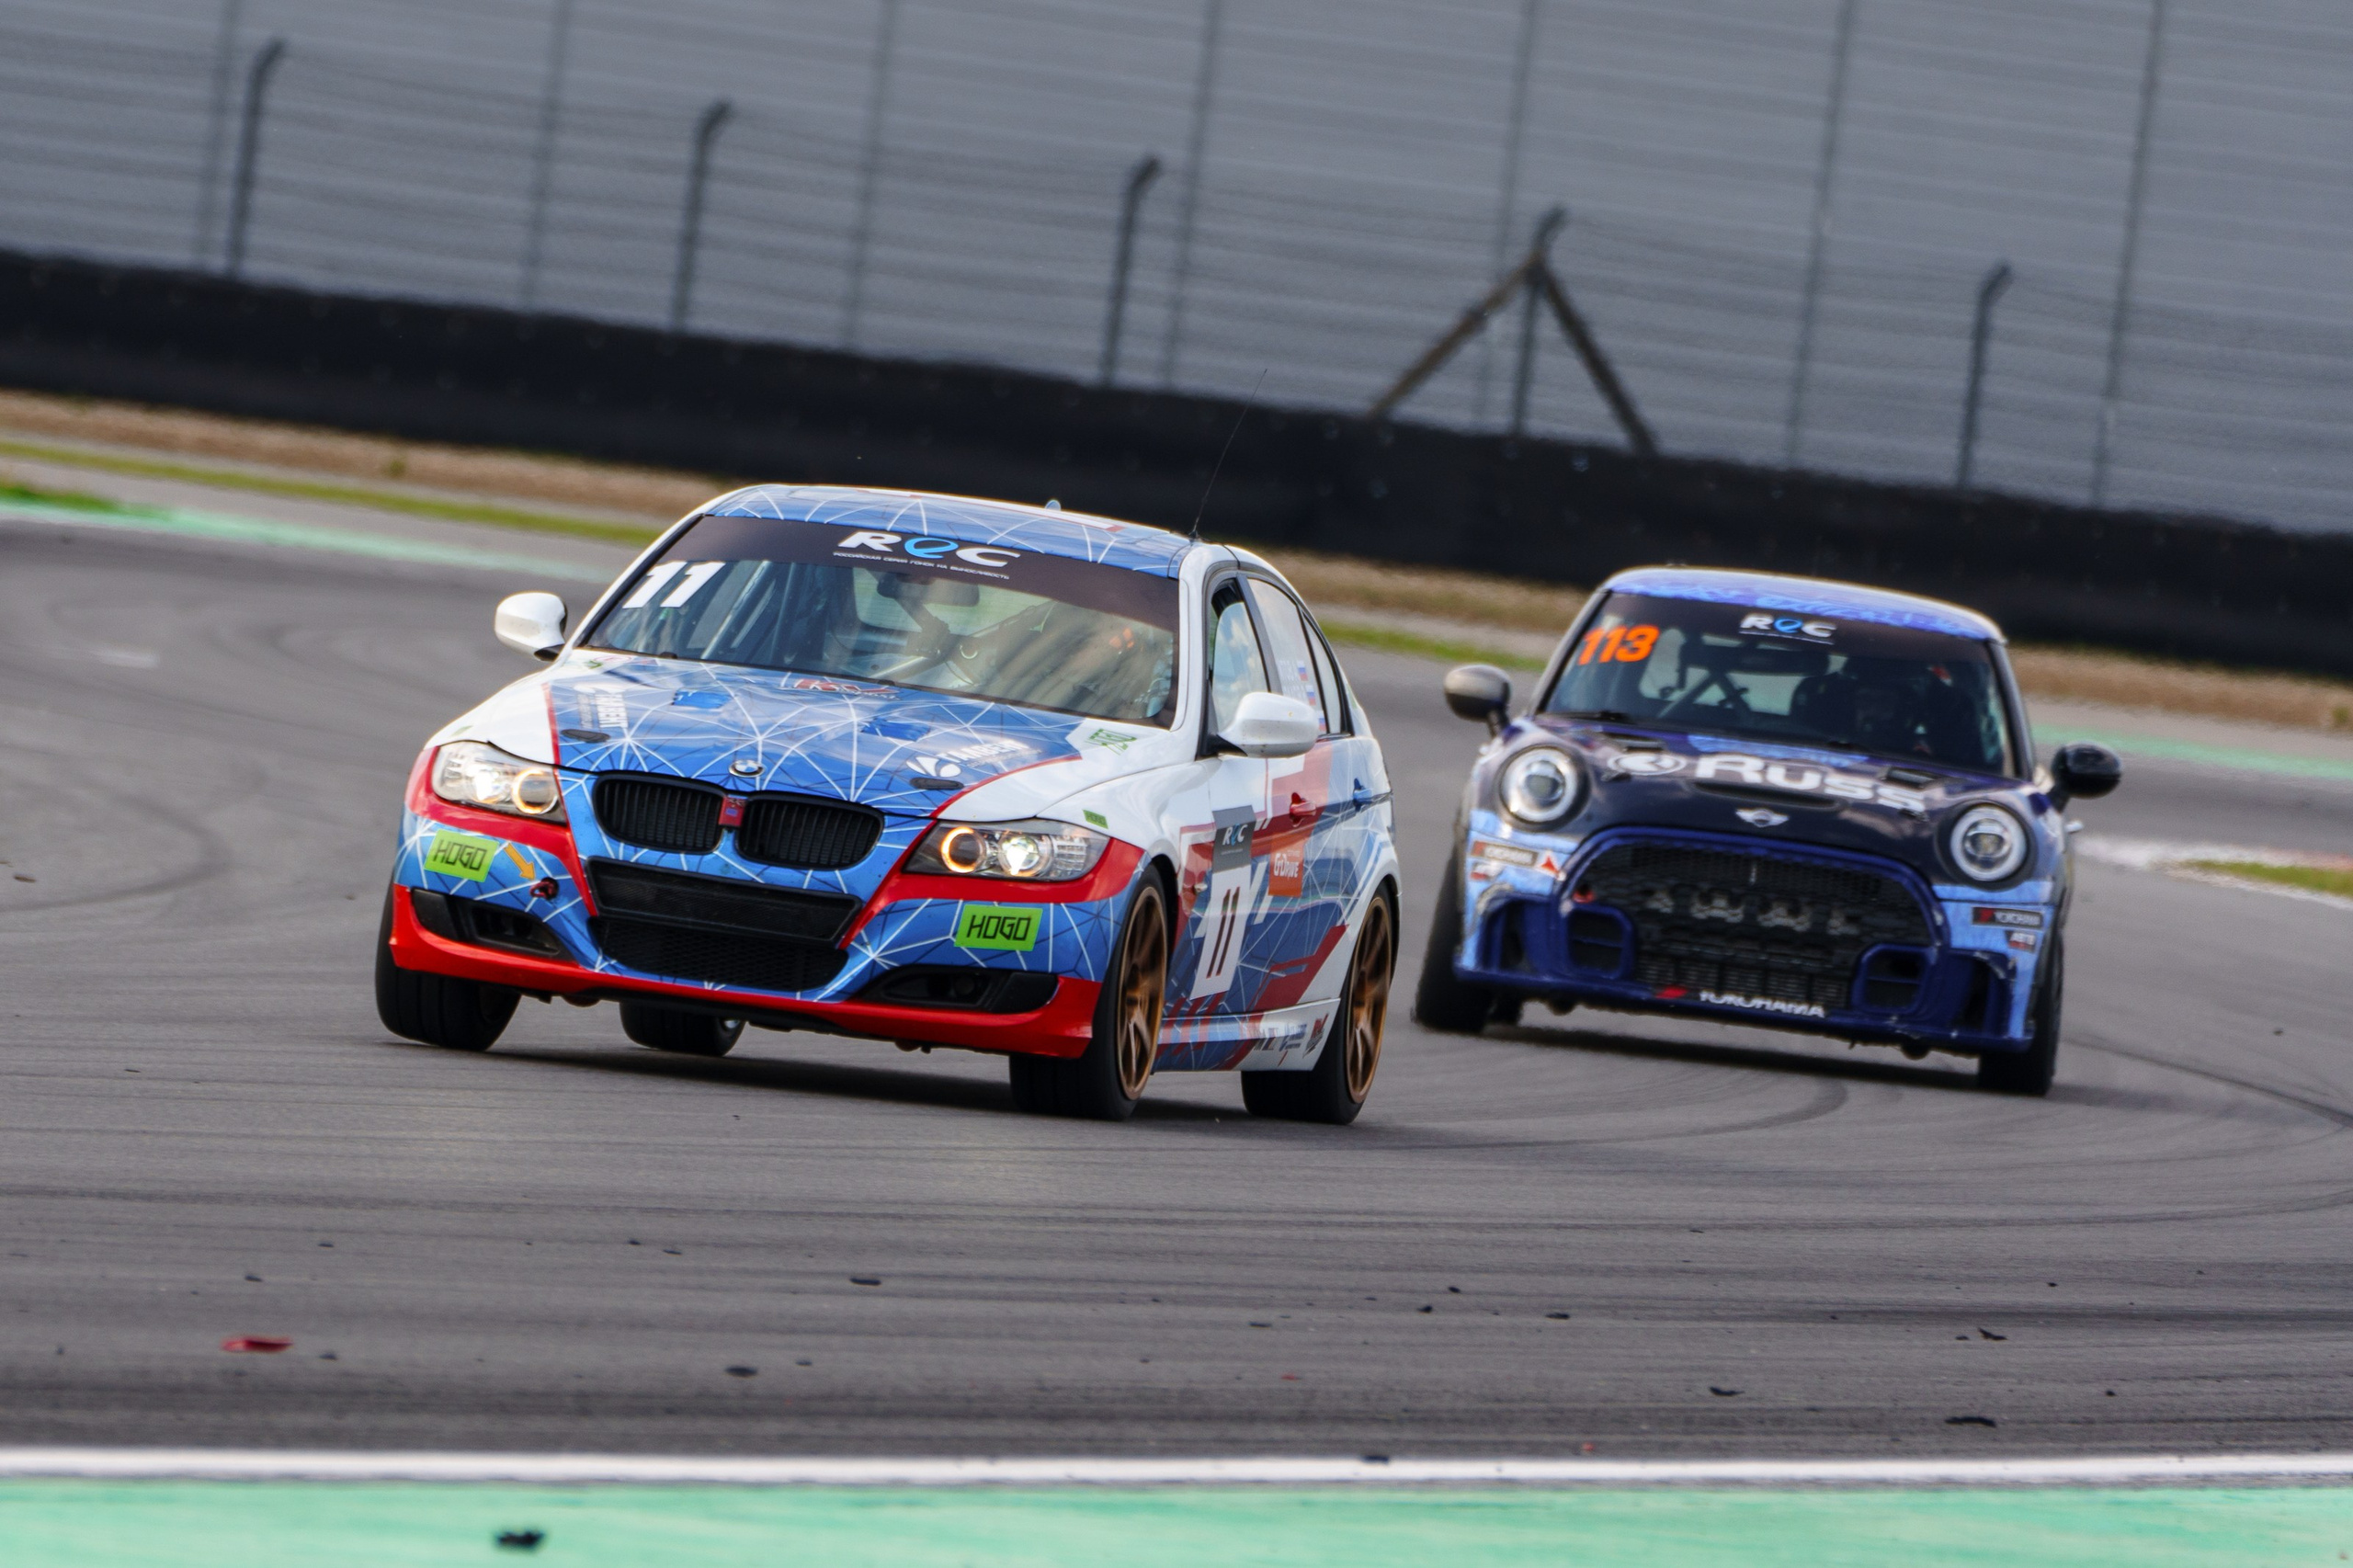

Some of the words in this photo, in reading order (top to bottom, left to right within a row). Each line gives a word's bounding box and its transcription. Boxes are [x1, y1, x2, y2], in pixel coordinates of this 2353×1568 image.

[622, 561, 726, 608] 11
[1577, 624, 1660, 666] 113
[433, 839, 488, 872] HOGO
[966, 915, 1031, 941] HOGO
[1206, 886, 1240, 980] 11
